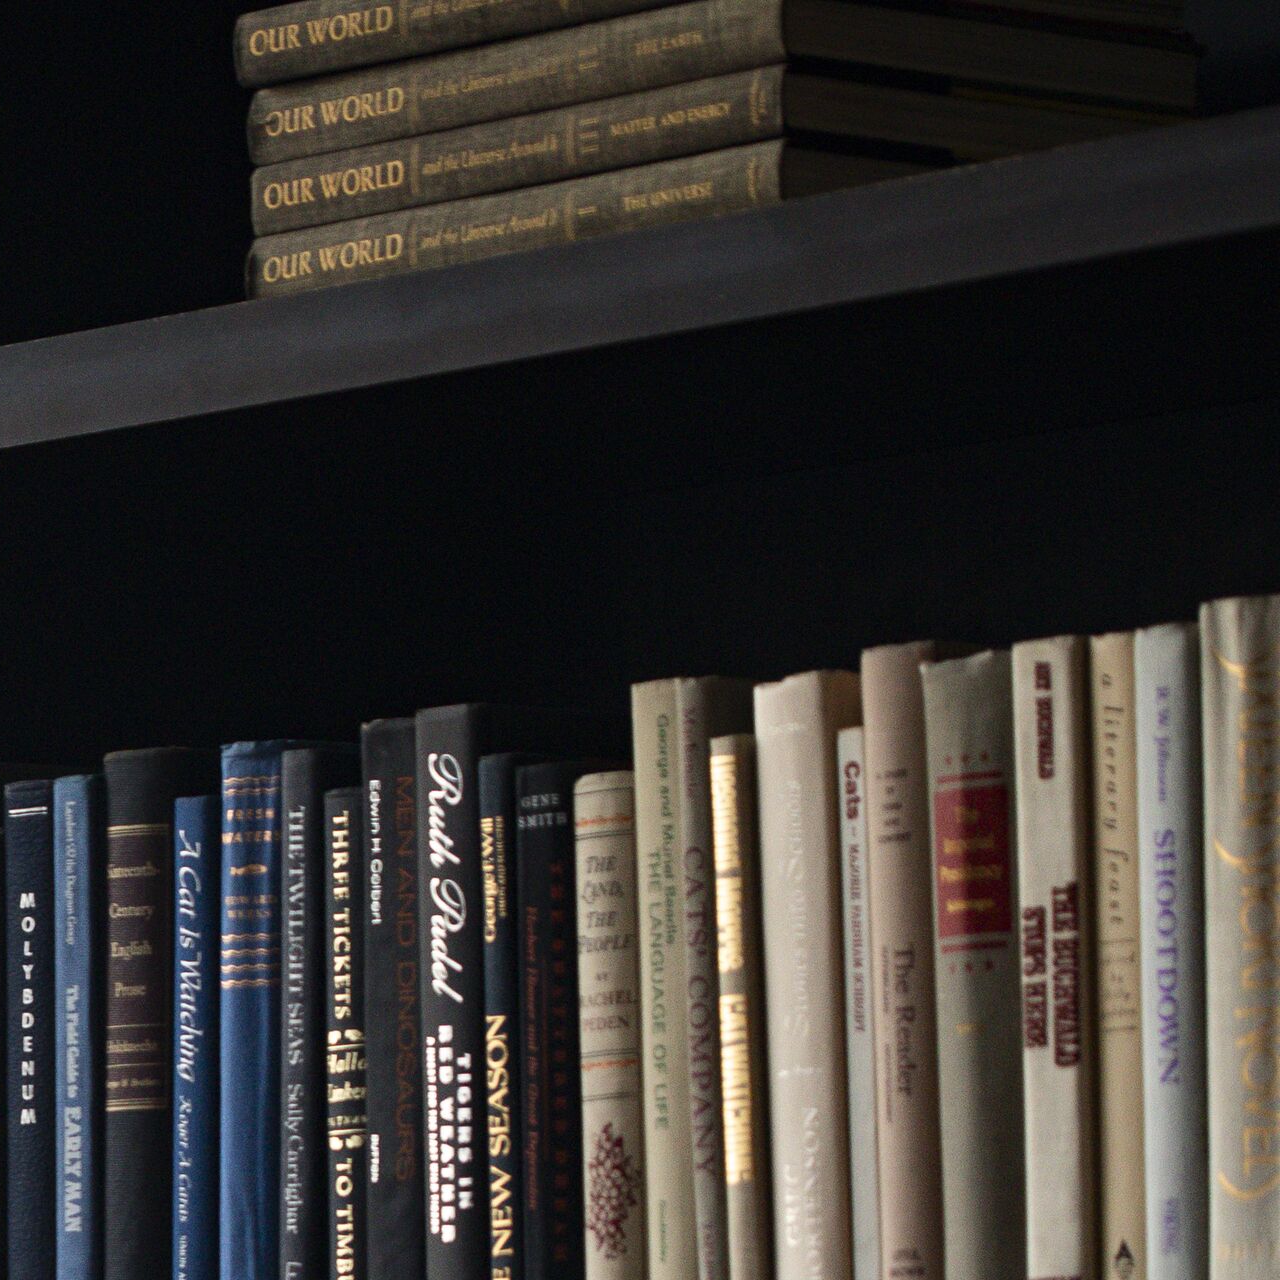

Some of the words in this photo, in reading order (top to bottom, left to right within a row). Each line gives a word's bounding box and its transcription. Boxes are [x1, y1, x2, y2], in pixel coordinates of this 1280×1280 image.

[250, 26, 301, 56] OUR
[307, 6, 392, 44] WORLD
[265, 105, 314, 136] OUR
[319, 86, 404, 126] WORLD
[263, 180, 314, 209] OUR
[320, 160, 404, 202] WORLD
[263, 253, 313, 283] OUR
[320, 233, 402, 272] WORLD
[844, 761, 862, 819] Cats
[1100, 703, 1124, 833] literary
[288, 807, 305, 860] THE
[369, 780, 381, 834] Edwin
[396, 776, 415, 855] MEN
[428, 753, 464, 865] Ruth
[179, 830, 202, 860] A
[332, 811, 350, 900] THREE
[648, 852, 662, 893] THE
[180, 866, 201, 916] Cat
[370, 859, 383, 924] Colbert
[397, 869, 416, 946] AND
[1052, 882, 1078, 933] THE
[1105, 850, 1128, 925] feast
[179, 928, 201, 947] Is
[289, 863, 306, 995] TWILIGHT
[431, 879, 467, 1002] Padel
[1155, 830, 1179, 1085] SHOOTDOWN
[333, 907, 352, 1020] TICKETS
[649, 903, 667, 1035] LANGUAGE
[893, 944, 916, 994] The
[19, 892, 38, 1125] MOLYBDENUM
[67, 985, 78, 1007] The
[67, 1011, 78, 1041] Field
[176, 952, 204, 1081] Watching
[289, 1003, 306, 1065] SEAS
[440, 1025, 453, 1084] RED
[654, 1044, 667, 1074] OF
[895, 1005, 917, 1096] Reader
[67, 1084, 78, 1097] to
[397, 962, 418, 1180] DINOSAURS
[485, 1014, 512, 1157] SEASON
[689, 975, 715, 1178] COMPANY
[175, 1097, 191, 1145] Roger
[285, 1084, 305, 1132] Sally
[457, 1053, 472, 1163] TIGERS
[654, 1084, 668, 1131] LIFE
[65, 1107, 81, 1179] EARLY
[441, 1097, 456, 1243] WEATHER
[284, 1137, 304, 1234] Carrighar
[336, 1158, 353, 1195] TO
[459, 1177, 474, 1209] IN
[65, 1182, 81, 1232] MAN
[491, 1165, 514, 1257] NEW
